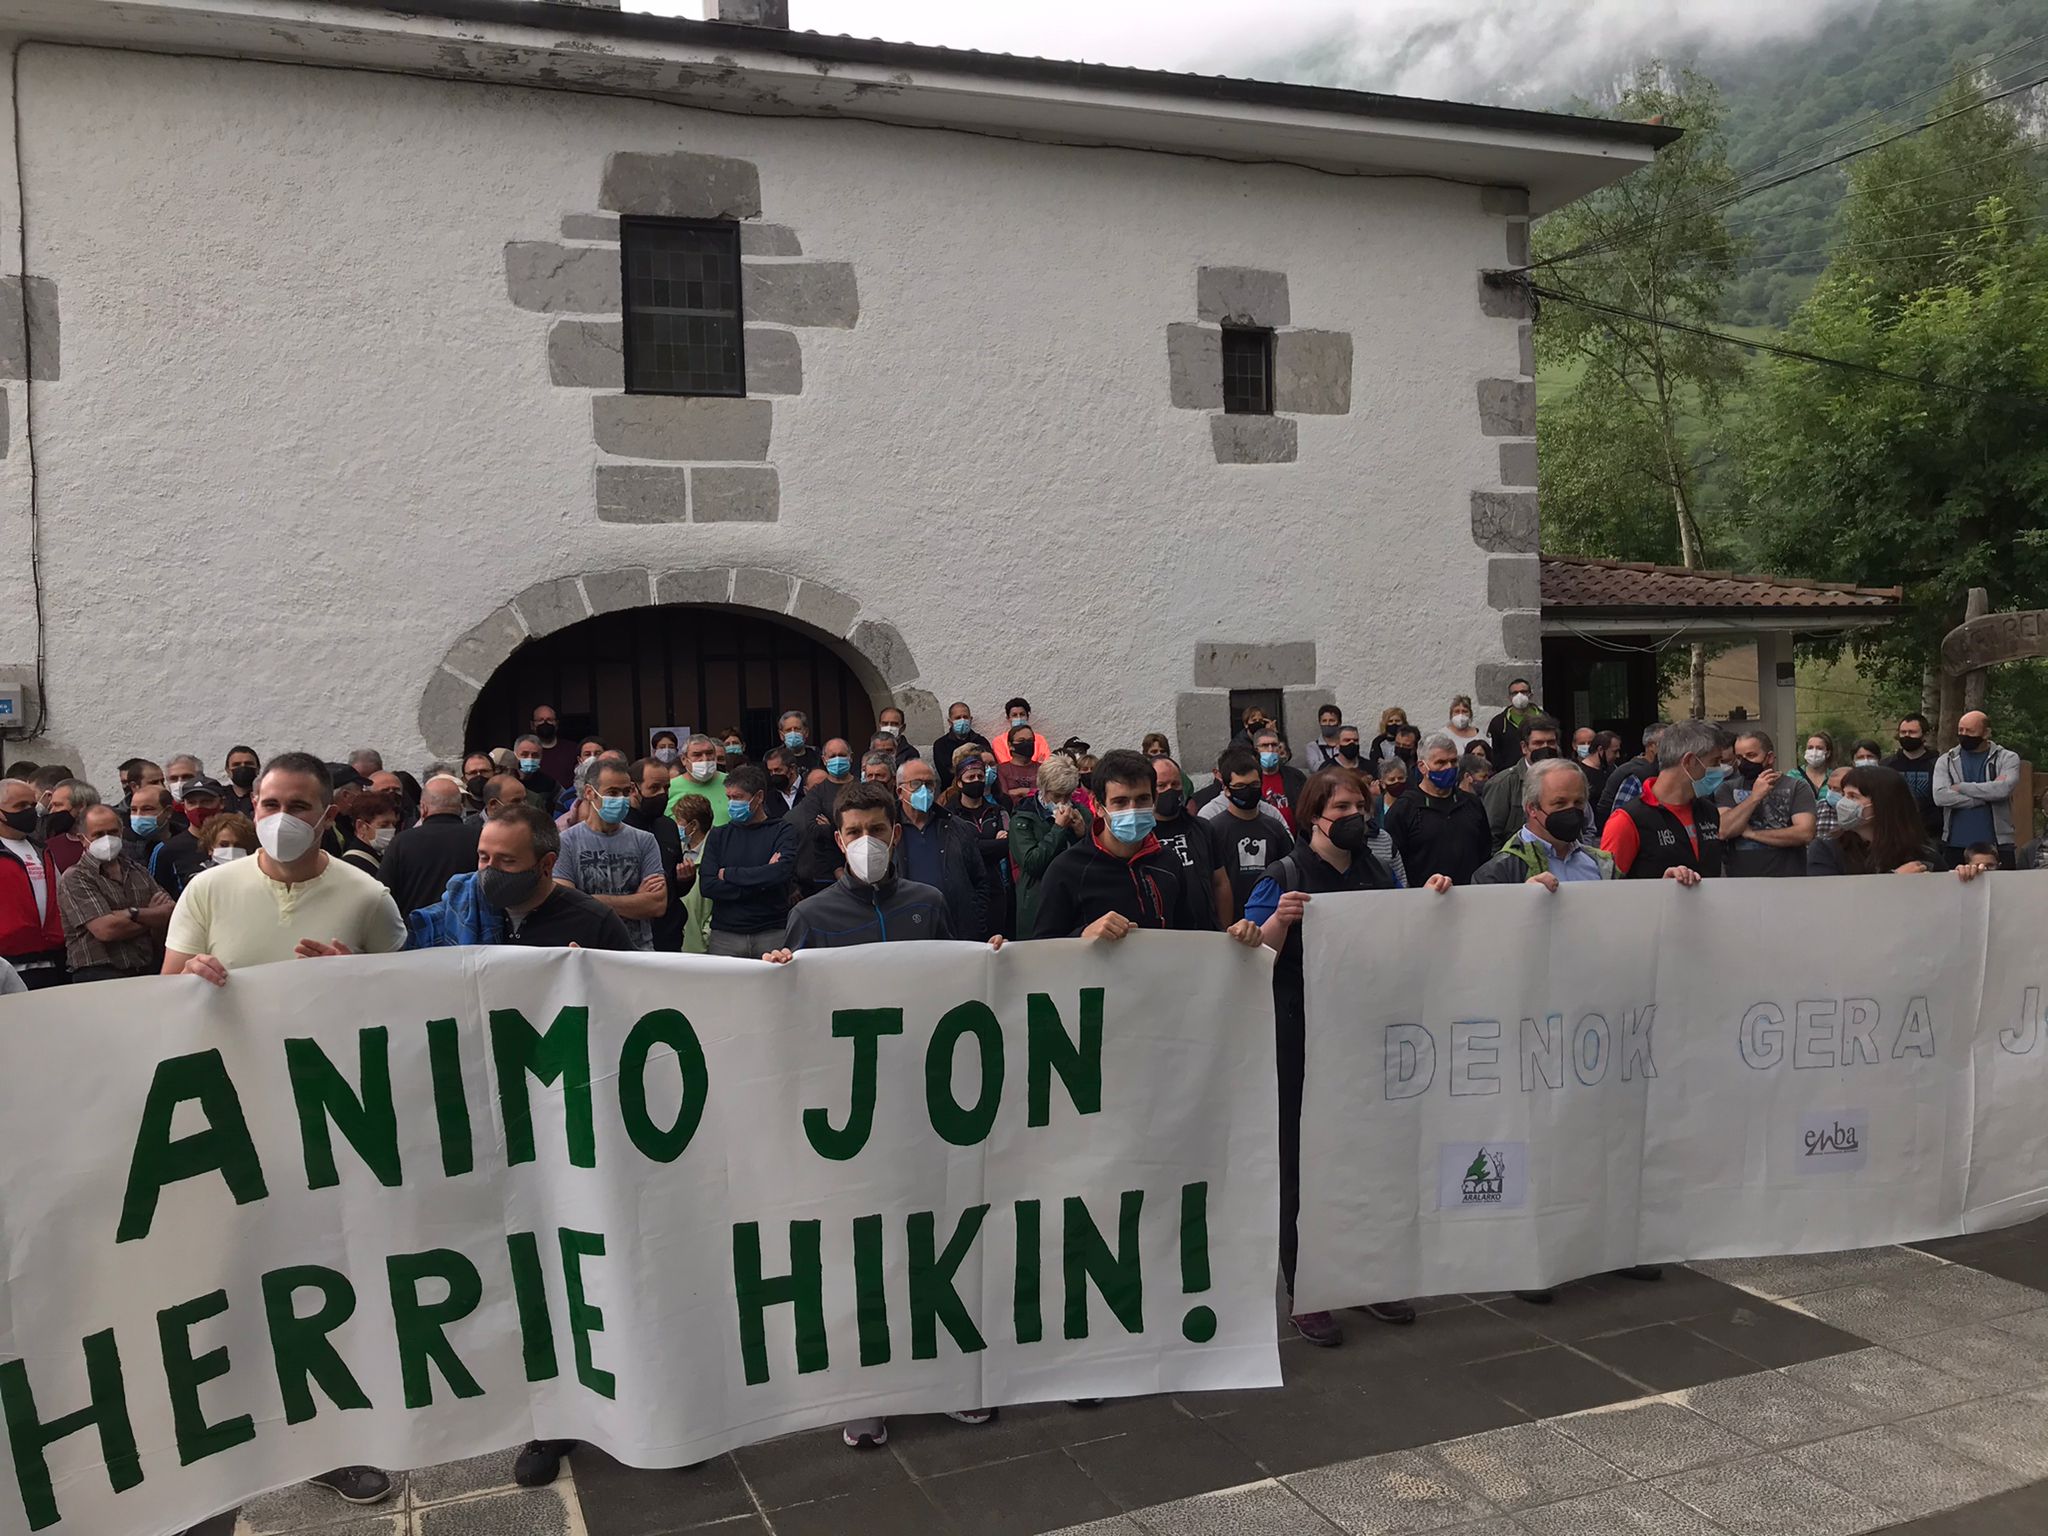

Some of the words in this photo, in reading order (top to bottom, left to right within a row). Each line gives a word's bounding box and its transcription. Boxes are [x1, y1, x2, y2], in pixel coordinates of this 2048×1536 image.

[117, 1006, 708, 1244] ANIMO
[803, 986, 1105, 1161] JON
[1384, 1004, 1659, 1101] DENOK
[1739, 996, 1936, 1070] GERA
[1999, 986, 2048, 1055] J
[1463, 1193, 1502, 1201] ARALARKO
[0, 1227, 617, 1531] HERRIE
[732, 1180, 1218, 1388] HIKIN!
